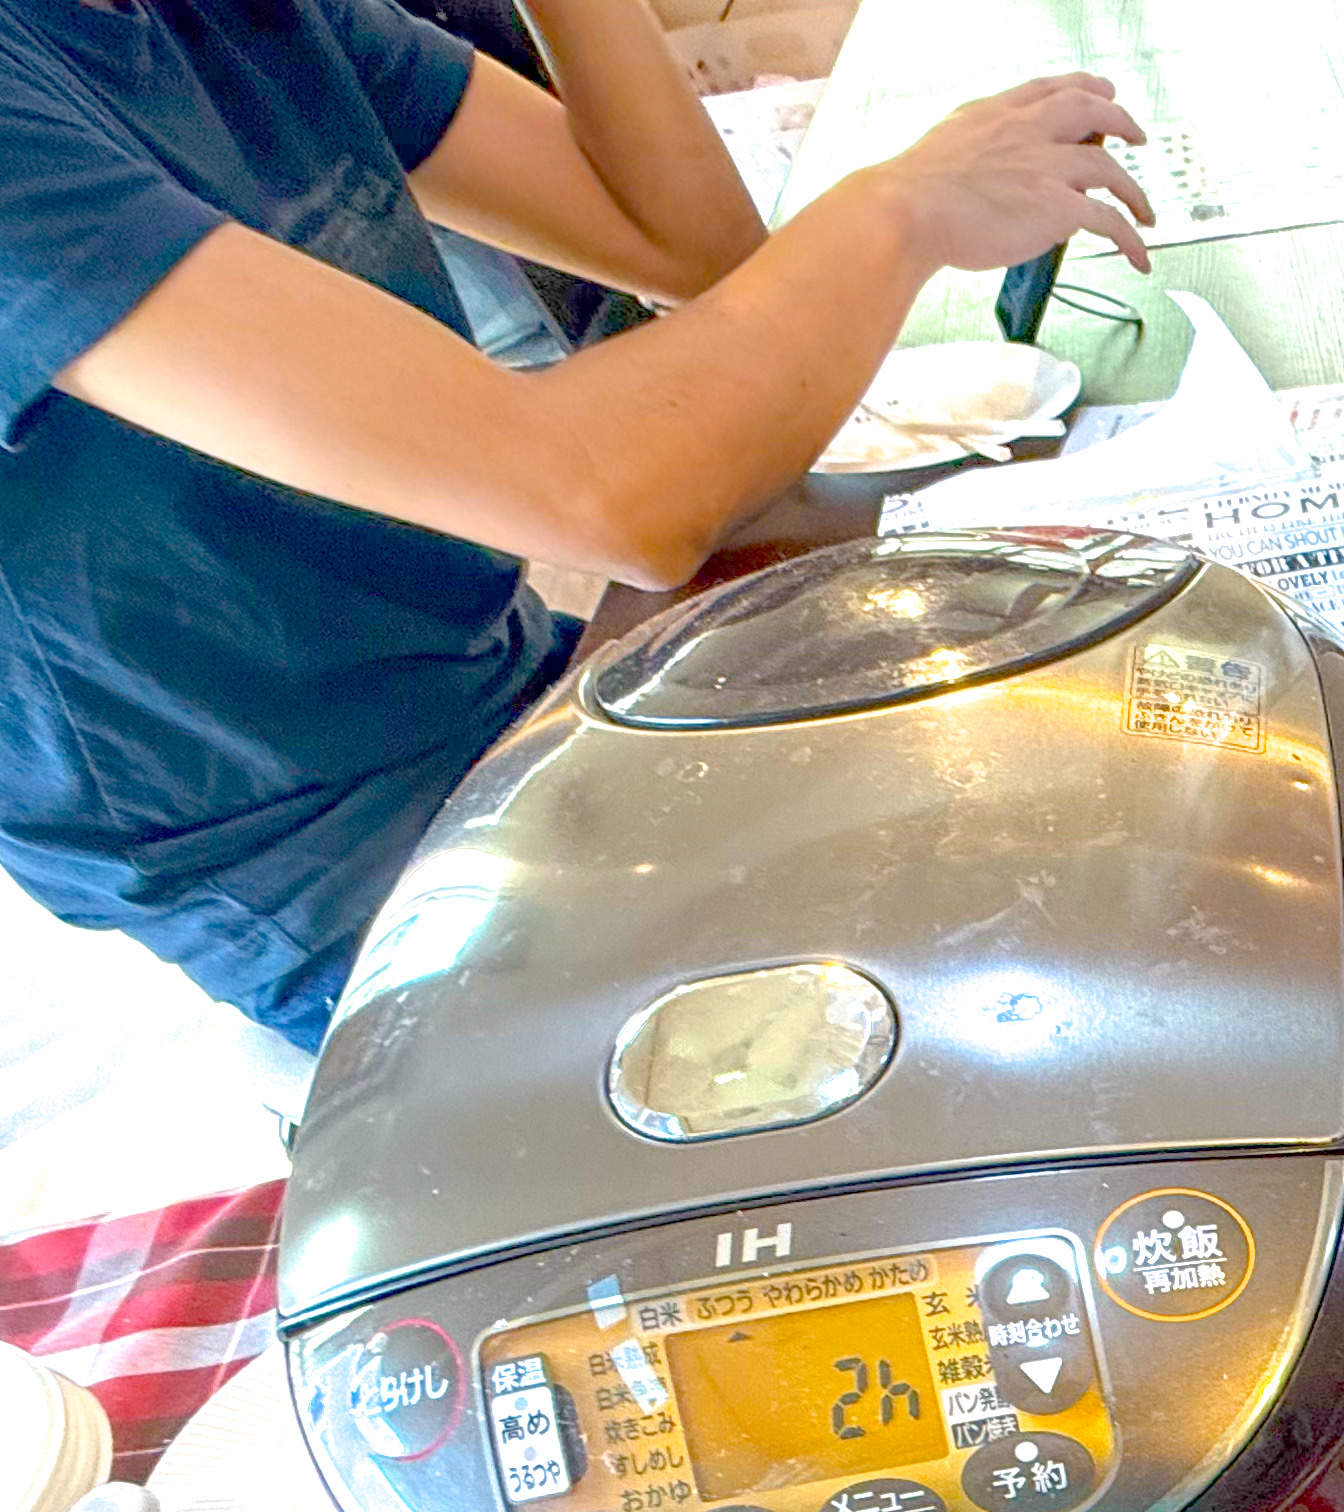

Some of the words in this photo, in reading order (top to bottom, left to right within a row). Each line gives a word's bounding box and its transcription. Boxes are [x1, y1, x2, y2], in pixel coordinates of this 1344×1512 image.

[1208, 540, 1244, 561] YOU
[1246, 536, 1283, 556] CAN
[1283, 527, 1338, 551] SHOUT
[1276, 570, 1330, 592] OVELY
[715, 1222, 792, 1267] IH
[1133, 1224, 1223, 1266] 炊飯
[639, 1301, 683, 1331] 白米
[697, 1290, 754, 1320] ふつう
[764, 1272, 864, 1308] やわらかめ
[869, 1258, 930, 1290] かため
[1143, 1265, 1227, 1295] 再加熱
[928, 1319, 987, 1351] 玄米熟
[988, 1313, 1081, 1348] 時刻合わせ
[491, 1358, 545, 1392] 保温
[832, 1354, 921, 1440] 2h
[500, 1413, 551, 1444] 高め
[604, 1410, 677, 1445] 炊きこみ
[509, 1459, 562, 1493] うるつや
[613, 1446, 684, 1477] すしめし
[621, 1479, 694, 1512] おかゆ
[992, 1460, 1068, 1500] 予約
